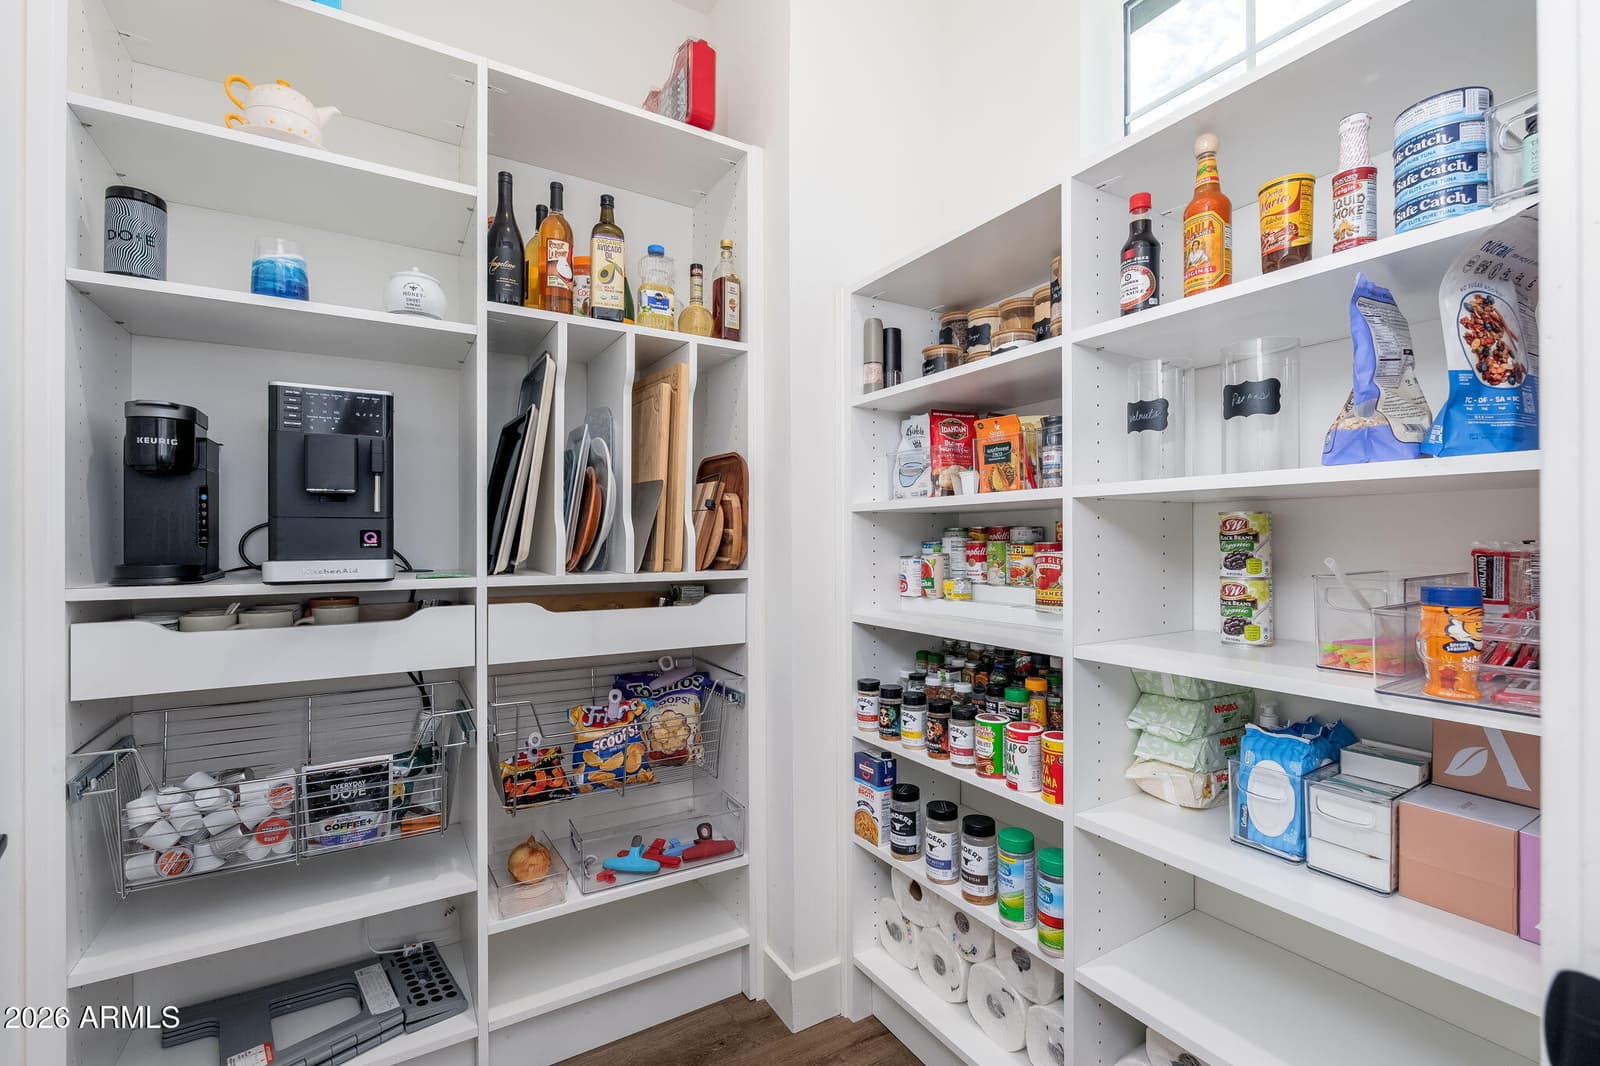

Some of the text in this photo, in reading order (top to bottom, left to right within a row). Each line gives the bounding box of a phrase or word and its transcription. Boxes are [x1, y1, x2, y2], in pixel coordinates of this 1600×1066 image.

[1405, 132, 1454, 154] Catch
[1396, 159, 1474, 193] Safe Catch
[1333, 193, 1366, 210] IQUID
[1395, 191, 1473, 223] Safe Catch
[1333, 205, 1364, 221] MOKE
[1184, 220, 1216, 240] OLULA
[136, 436, 179, 446] KEURIG
[364, 532, 378, 544] Q
[1233, 533, 1254, 541] BEANS
[1478, 556, 1488, 597] KIRKLAND
[592, 724, 640, 753] SCOOPS!
[1042, 754, 1056, 766] LAP
[324, 817, 373, 832] COFFEE+
